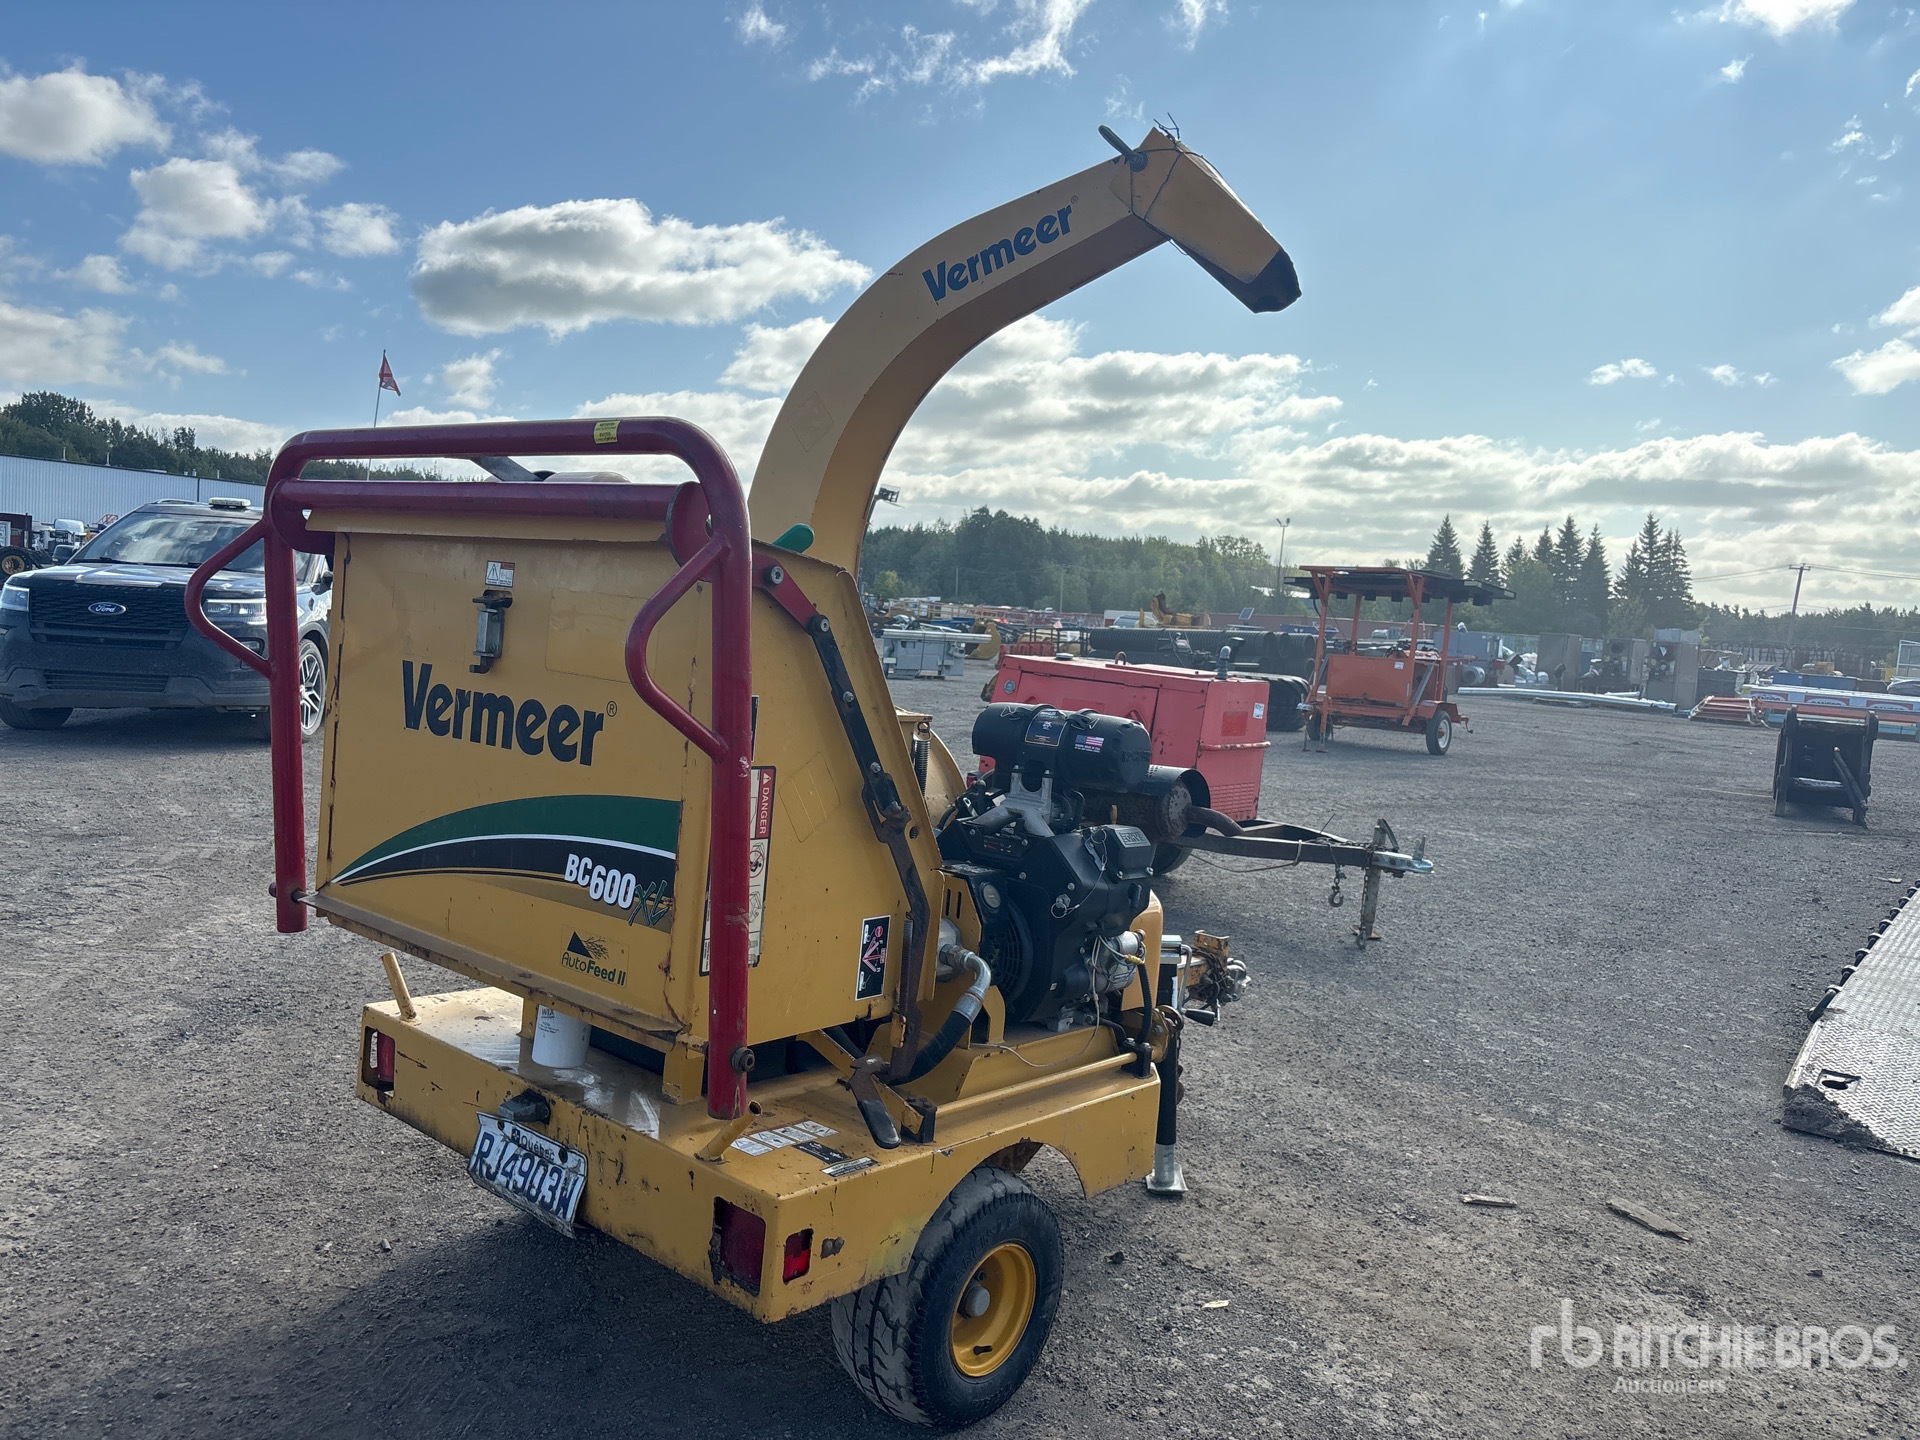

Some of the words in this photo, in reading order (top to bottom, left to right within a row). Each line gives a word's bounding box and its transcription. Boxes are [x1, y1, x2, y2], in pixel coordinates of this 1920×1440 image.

[922, 205, 1073, 301] Vermeer
[402, 660, 604, 766] Vermeer
[759, 787, 770, 834] DANGER
[561, 951, 616, 982] AutoFeed
[520, 1135, 556, 1162] Québec
